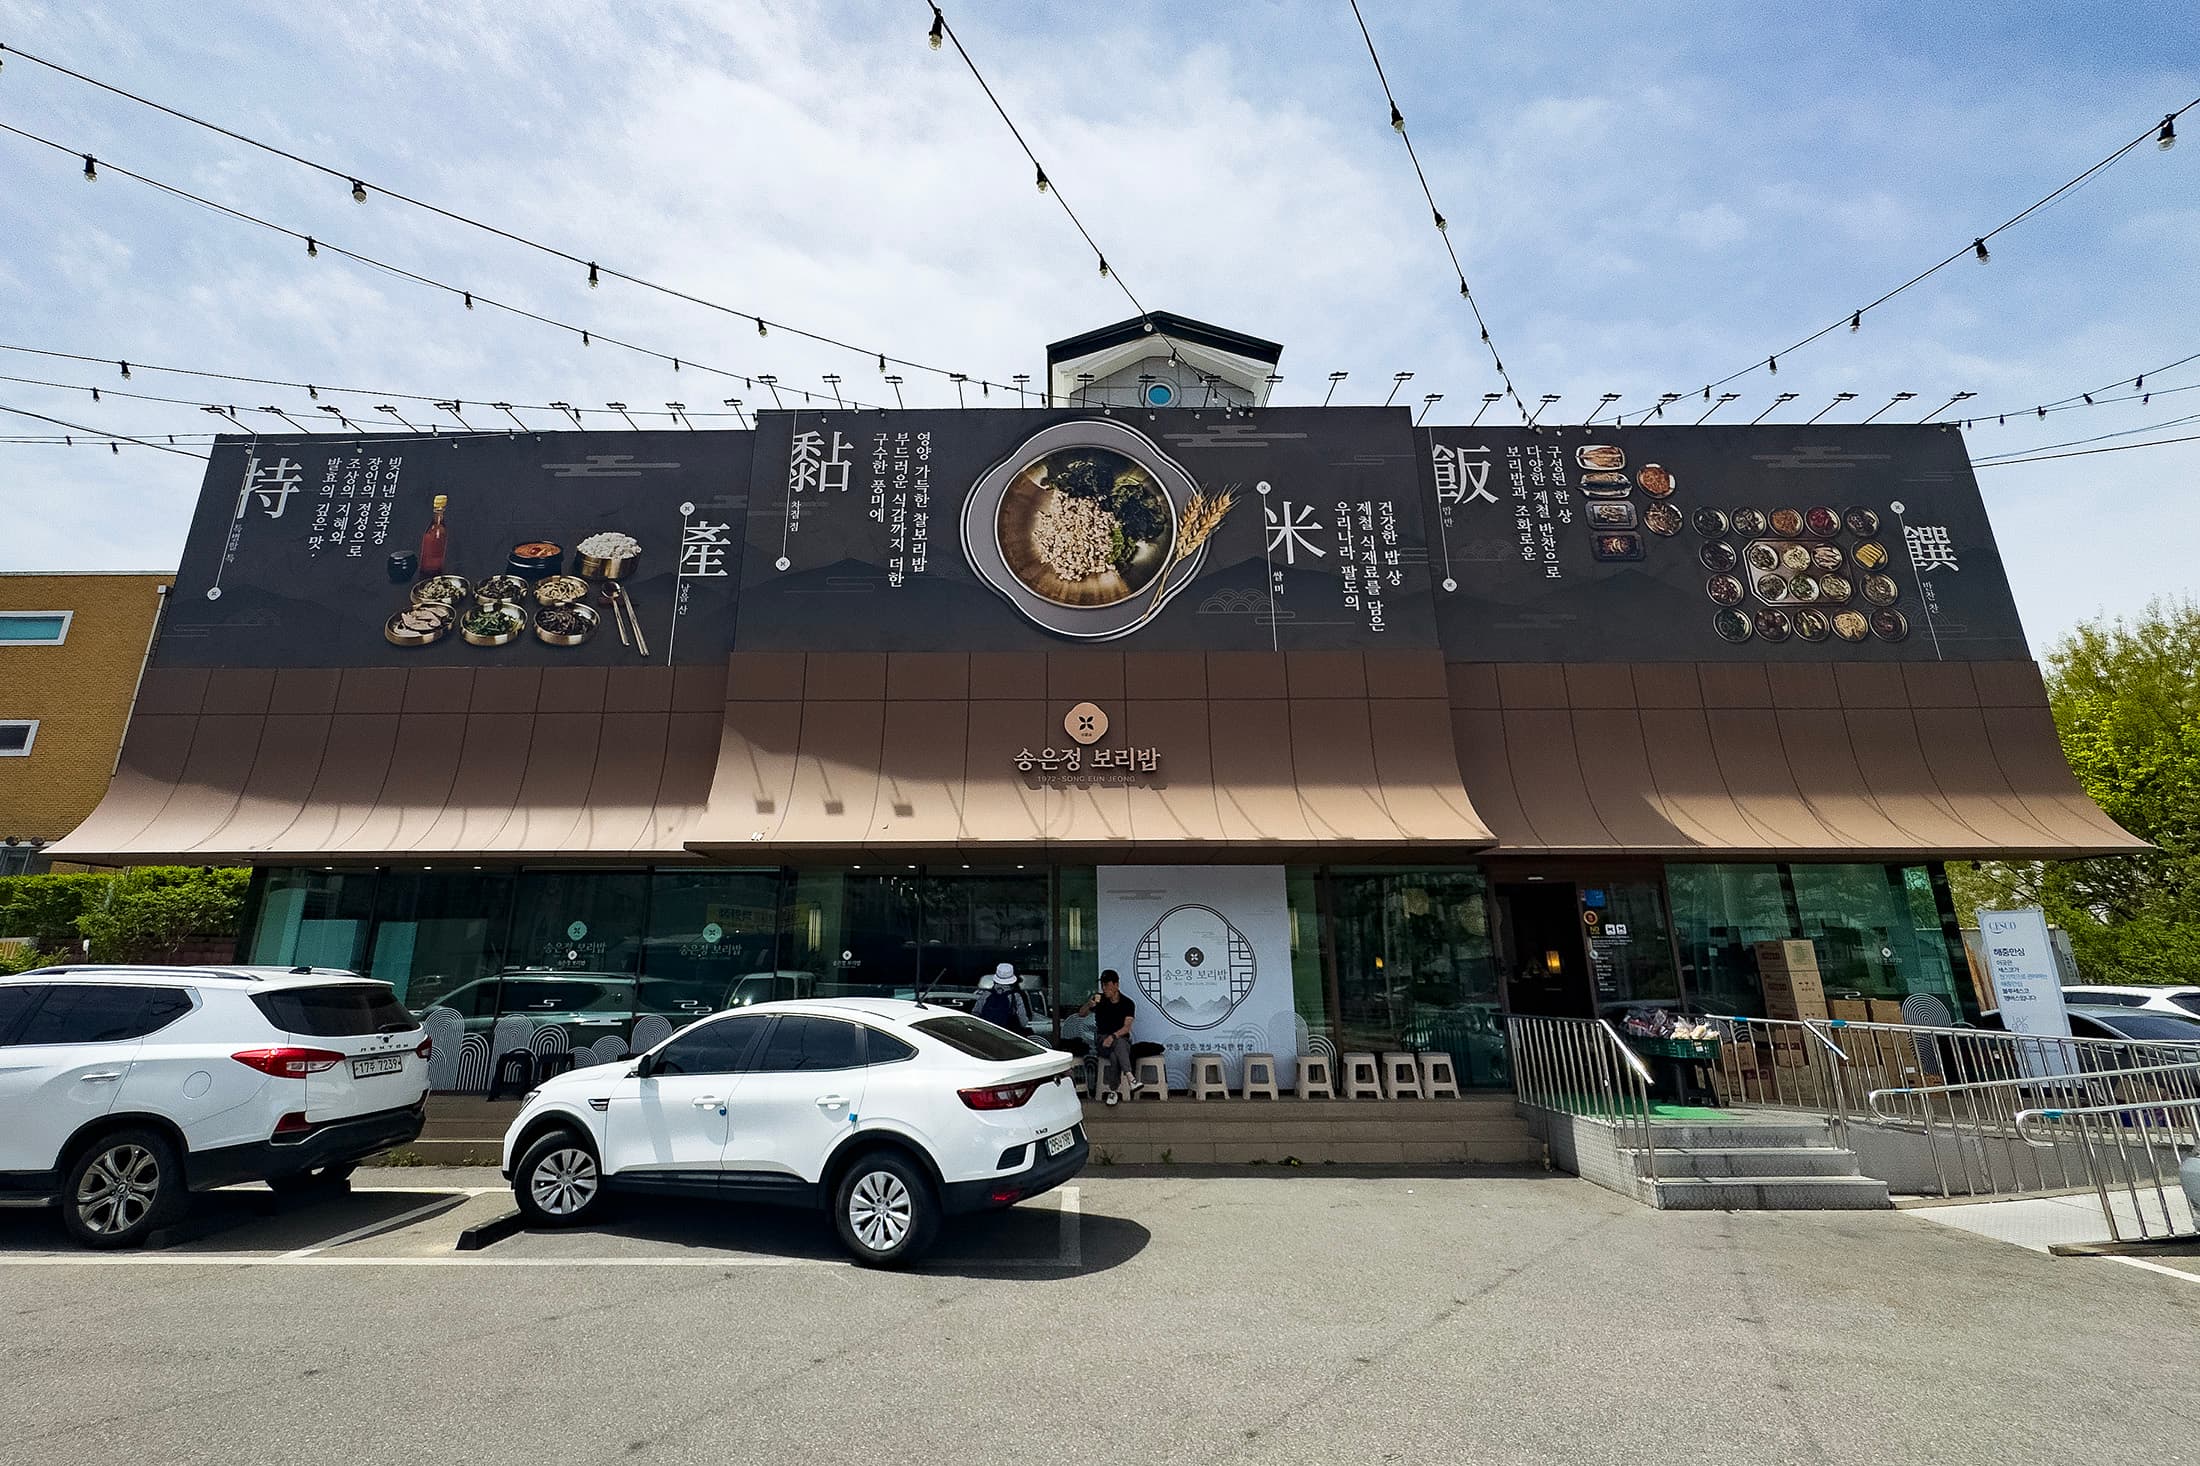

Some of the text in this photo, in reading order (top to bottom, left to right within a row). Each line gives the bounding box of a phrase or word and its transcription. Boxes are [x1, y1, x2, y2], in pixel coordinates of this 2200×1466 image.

[308, 457, 342, 558] 발효의 깊은 맛.
[329, 457, 361, 545] 조상의 지혜와
[346, 457, 382, 558] 장인의 정성으로
[371, 456, 402, 545] 빚어낸 청국장
[869, 432, 889, 523] 구수한 풍미에
[888, 432, 910, 588] 부드러운 식감까지 더한
[911, 431, 932, 573] 영양 가득한 찰보리밥
[1432, 444, 1500, 504] 飯
[1506, 446, 1537, 561] 보리밥과 조화로운
[1526, 445, 1562, 579] 다양한 제철 반찬으로
[1546, 446, 1573, 524] 구성된 한 상
[1265, 501, 1327, 565] 米
[1334, 500, 1360, 611] 우리나라 팔도의
[1356, 500, 1385, 632] 제철 식재료를 담은
[1378, 501, 1398, 545] 건강한
[678, 604, 689, 615] 산
[1274, 584, 1284, 595] 미
[1013, 747, 1161, 771] 송은정 보리밥
[679, 943, 743, 956] 송은정 보리밥
[1163, 969, 1229, 981] 송은정 보리밥
[378, 1059, 398, 1071] 7239
